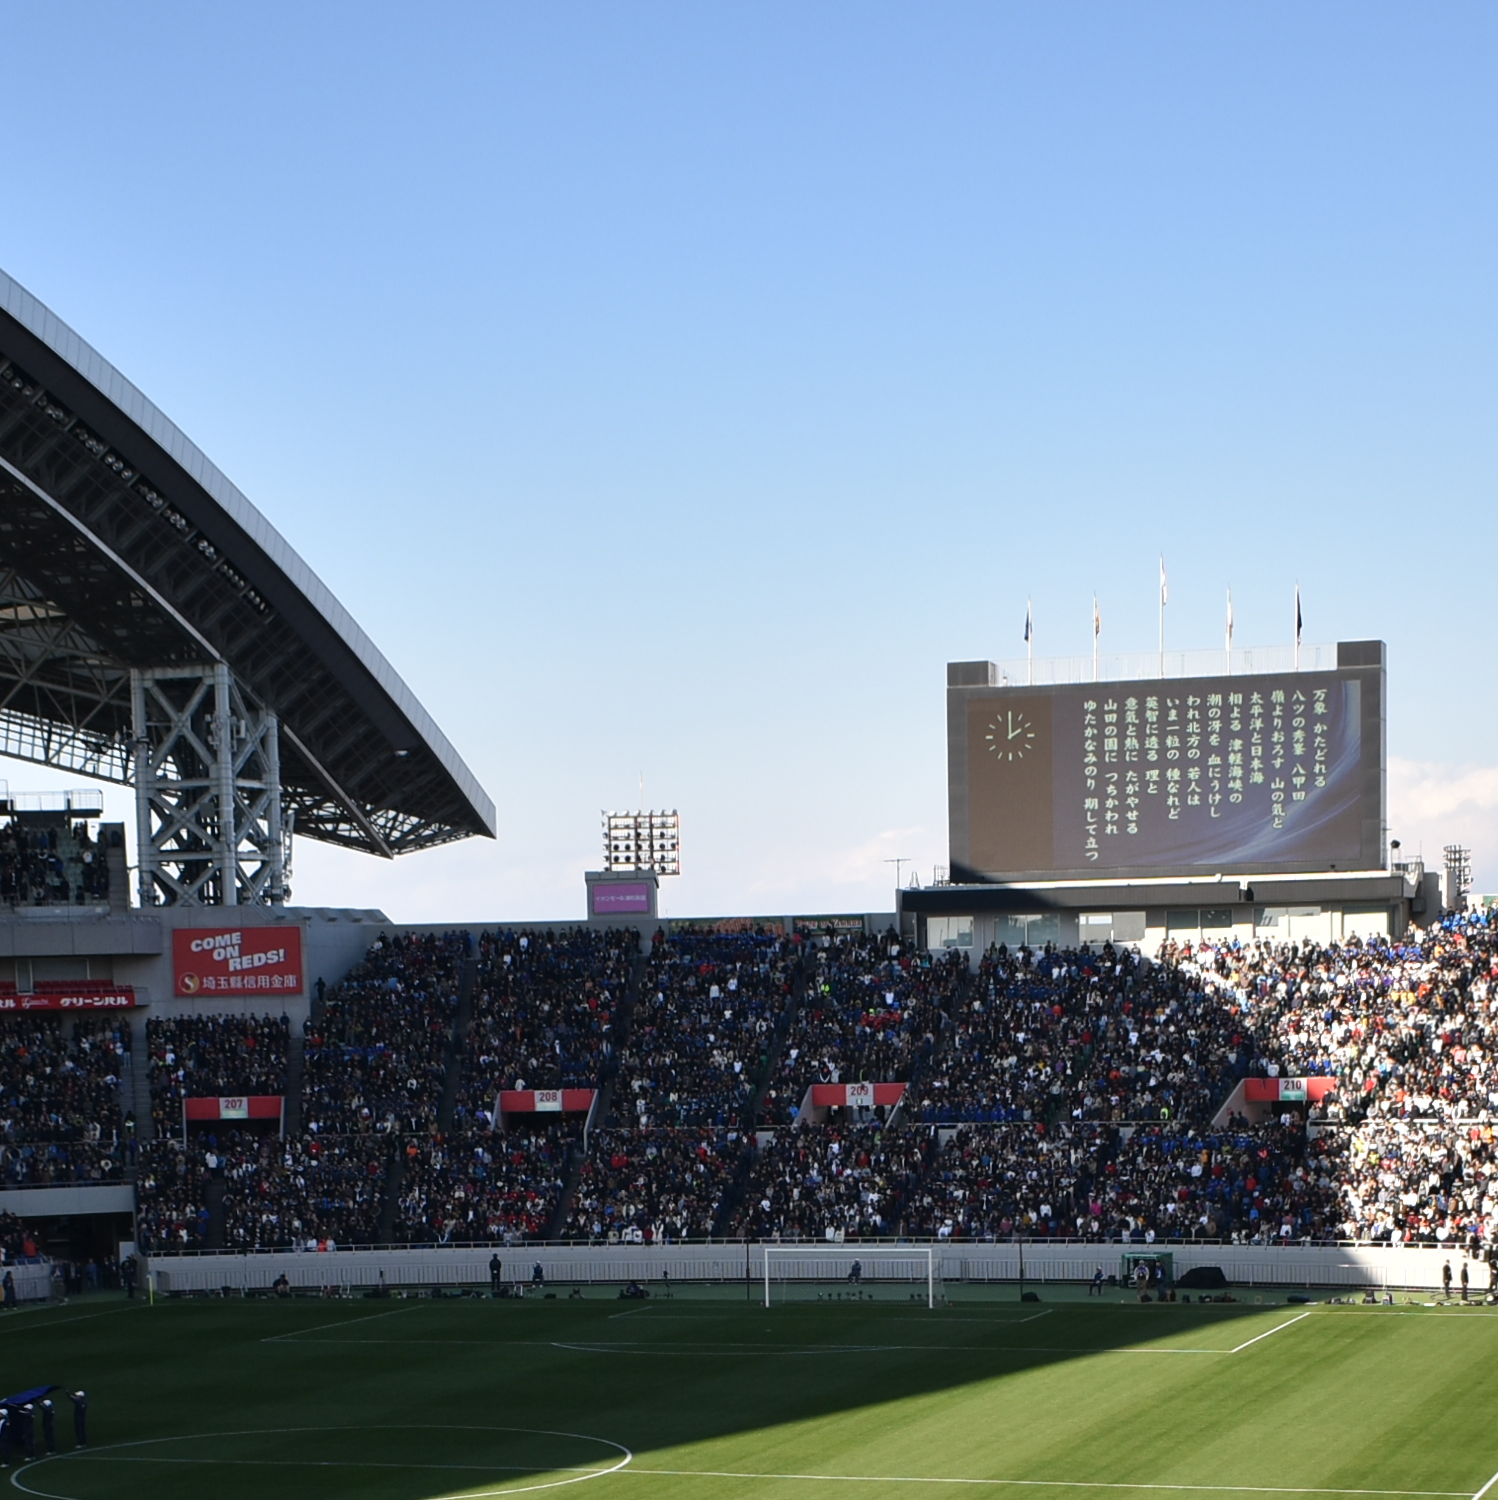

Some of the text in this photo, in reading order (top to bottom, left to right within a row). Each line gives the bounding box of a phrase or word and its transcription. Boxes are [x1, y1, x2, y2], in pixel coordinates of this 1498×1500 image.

[1165, 698, 1181, 820] いま一粒の 種なれど
[1186, 695, 1201, 805] われ北方の 若人は
[1228, 692, 1243, 803] 相よる 津軽海峡の
[1249, 692, 1264, 784] 太平洋と日本海
[1313, 722, 1328, 788] かたどれる
[1083, 700, 1099, 861] ゆたかなみのり 期して立つ
[1124, 697, 1139, 834] 意気と熱に たがやせる
[1145, 769, 1160, 794] 理と
[1208, 754, 1222, 818] 血にうけし
[1291, 763, 1306, 801] 八甲田
[1105, 772, 1119, 835] つちかわれ
[1271, 777, 1285, 828] 山の気と
[190, 932, 242, 953] COME
[212, 945, 240, 962] ON
[228, 948, 285, 972] REDS!
[224, 1099, 243, 1109] 207
[539, 1092, 557, 1102] 208
[850, 1086, 870, 1096] 209
[1283, 1080, 1302, 1090] 210
